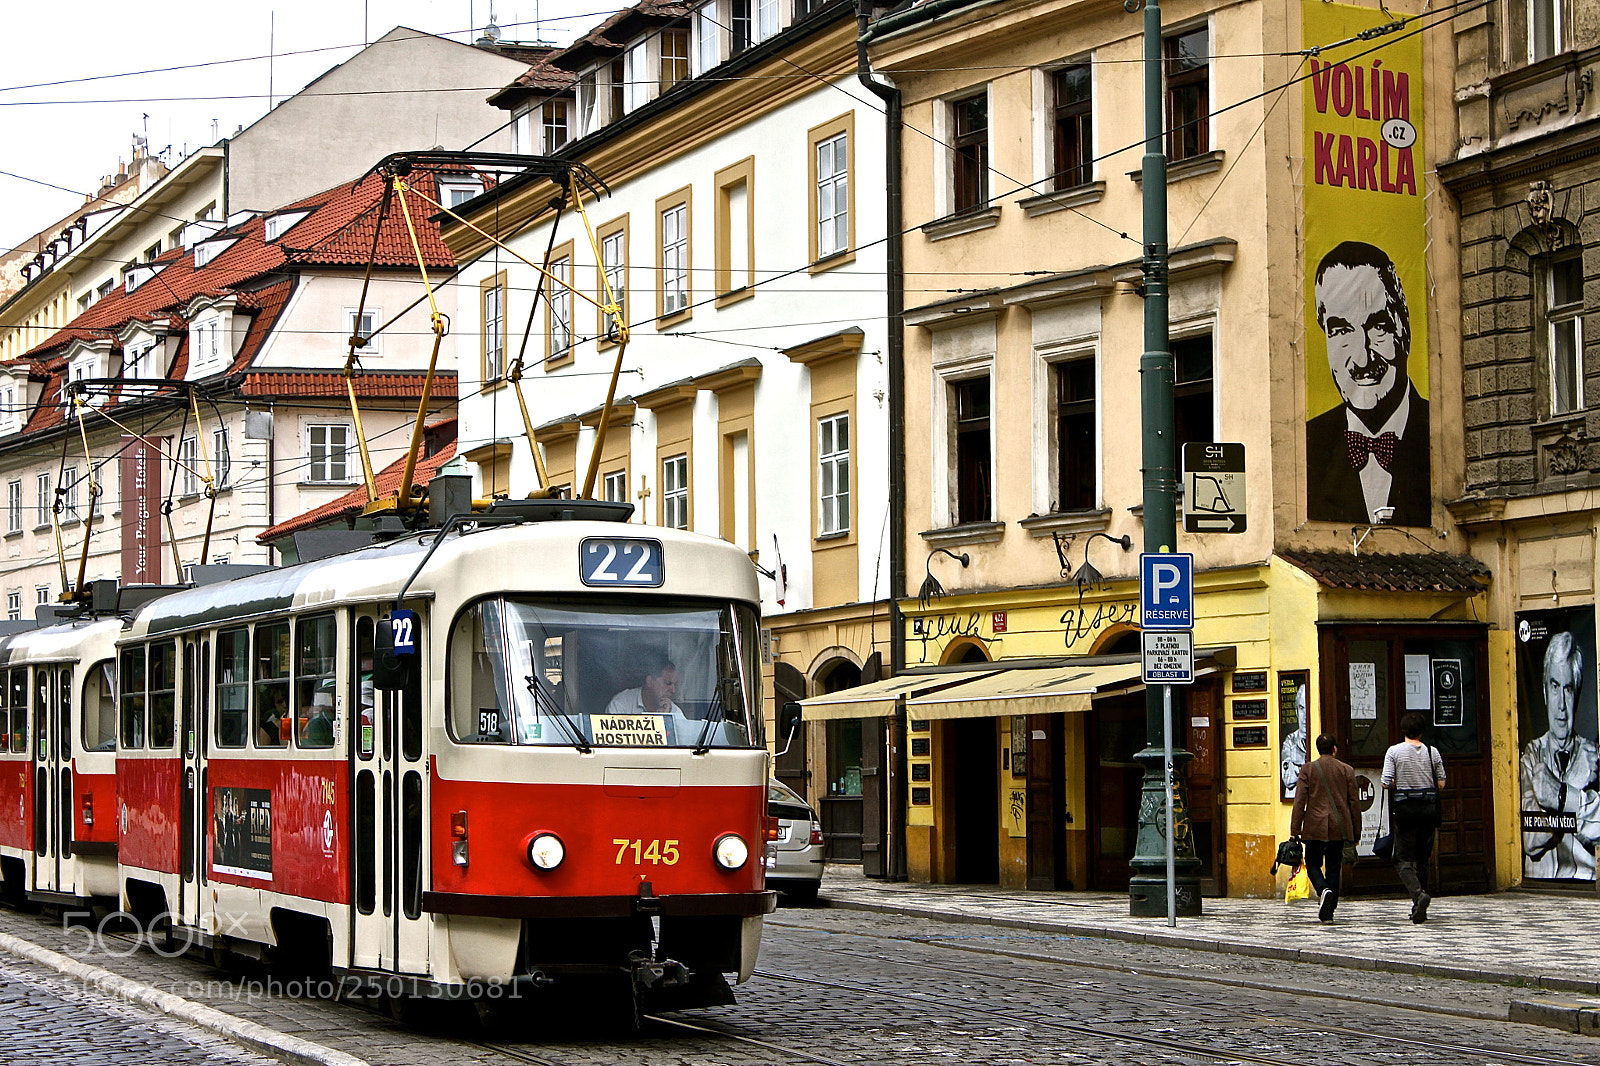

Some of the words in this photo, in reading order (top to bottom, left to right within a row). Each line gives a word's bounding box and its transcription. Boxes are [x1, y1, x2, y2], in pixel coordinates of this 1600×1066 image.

[1311, 59, 1409, 122] VOLÍM
[1314, 131, 1417, 196] KARLA
[135, 448, 146, 489] Hotels
[136, 495, 150, 539] Prague
[135, 544, 146, 575] Your
[588, 540, 653, 581] 22
[1152, 563, 1181, 604] P
[392, 617, 413, 648] 22
[480, 712, 498, 732] 518
[600, 716, 656, 731] NÁDRAŽÍ
[595, 731, 664, 745] HOSTIVAŘ
[321, 781, 334, 805] 7145
[612, 838, 680, 866] 7145
